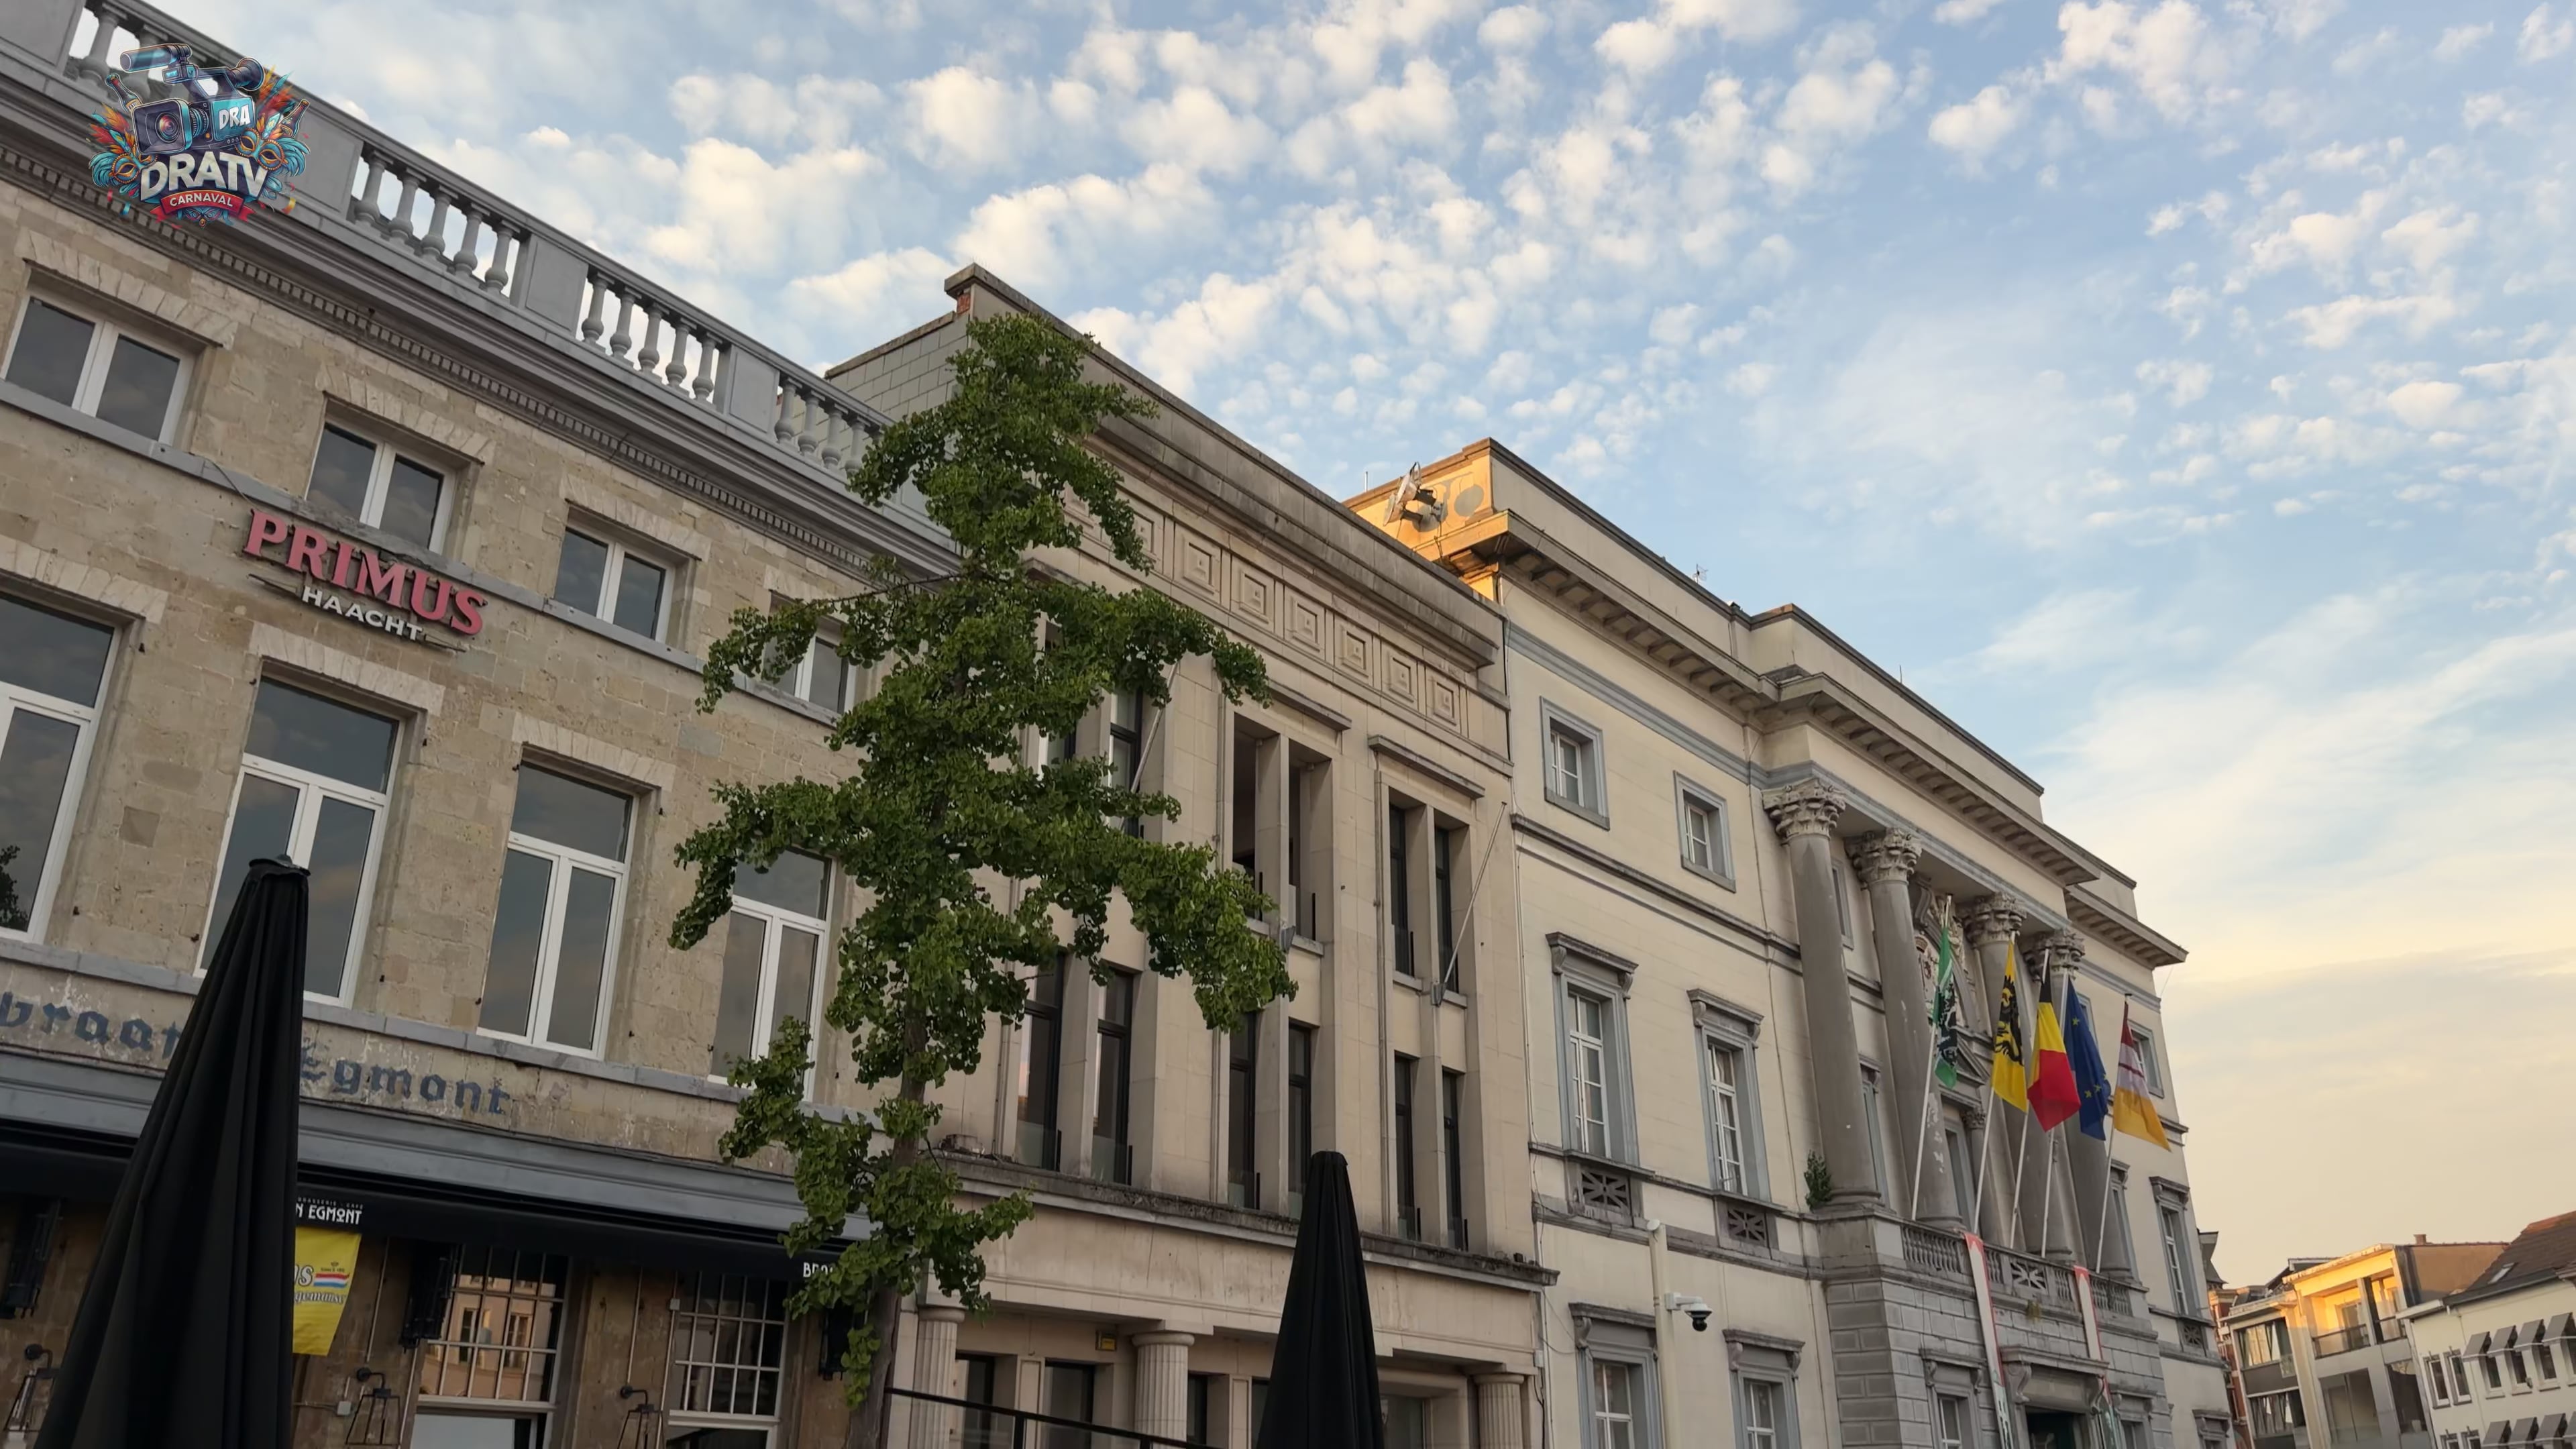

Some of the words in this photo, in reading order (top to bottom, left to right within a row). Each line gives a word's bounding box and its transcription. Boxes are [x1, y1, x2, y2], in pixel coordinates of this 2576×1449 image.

[243, 508, 484, 635] PRIMUS
[301, 586, 423, 641] HAACHT
[309, 1205, 362, 1224] EGMONT
